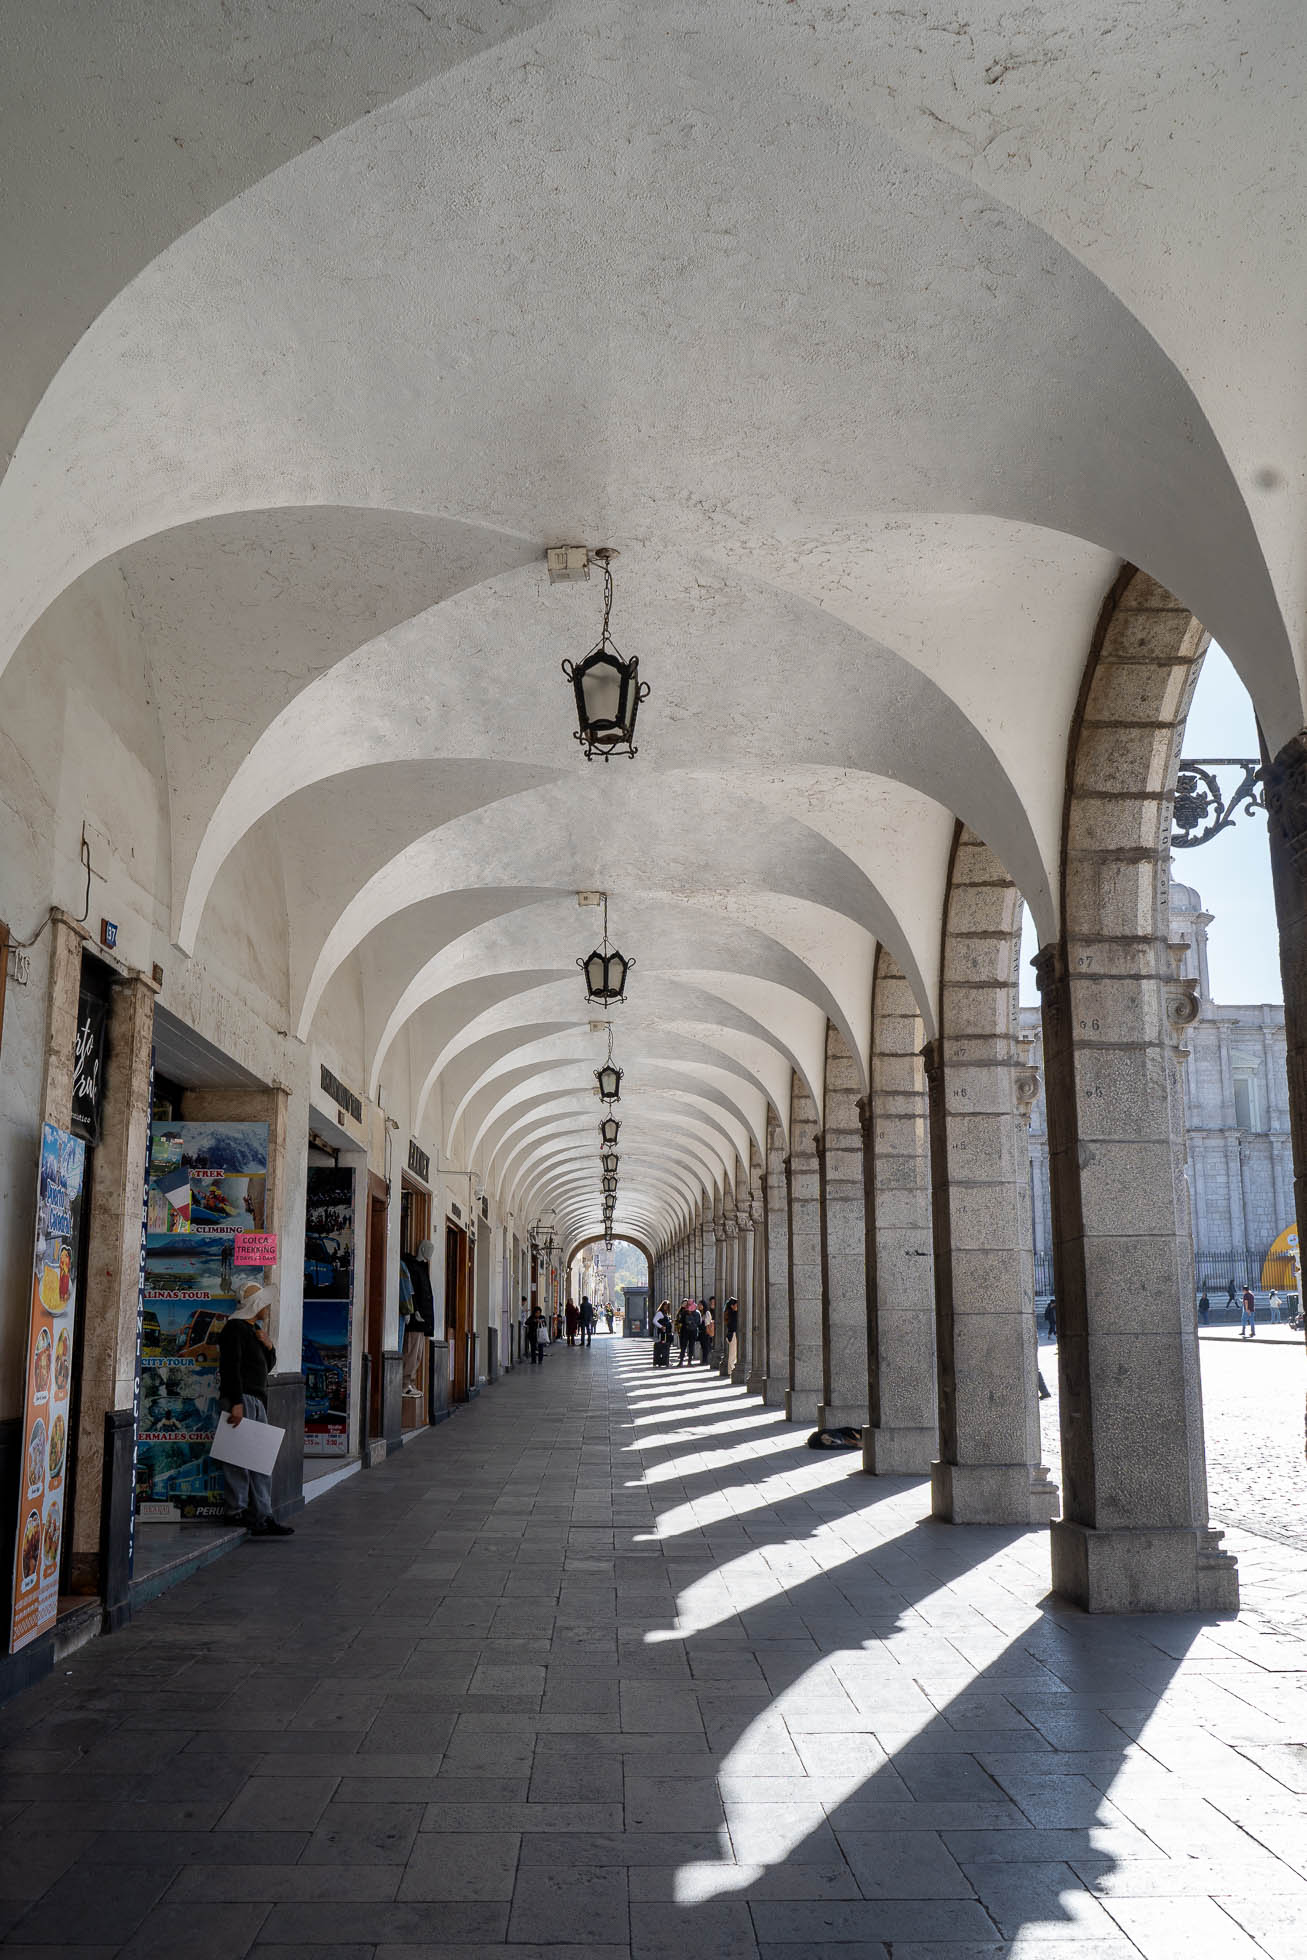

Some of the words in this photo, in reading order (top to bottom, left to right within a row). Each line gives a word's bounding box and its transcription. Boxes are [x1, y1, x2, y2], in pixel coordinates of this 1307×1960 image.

[106, 926, 117, 942] 37
[195, 1170, 225, 1178] TREK
[196, 1226, 243, 1234] CLIMBING
[242, 1236, 270, 1245] COLCA
[236, 1246, 276, 1254] TREKKING
[143, 1291, 179, 1299] ALINAS
[181, 1291, 210, 1299] TOUR
[141, 1358, 166, 1366] CITY
[167, 1358, 195, 1366] TOUR
[138, 1433, 187, 1441] ERMALES
[196, 1506, 225, 1517] PERU
